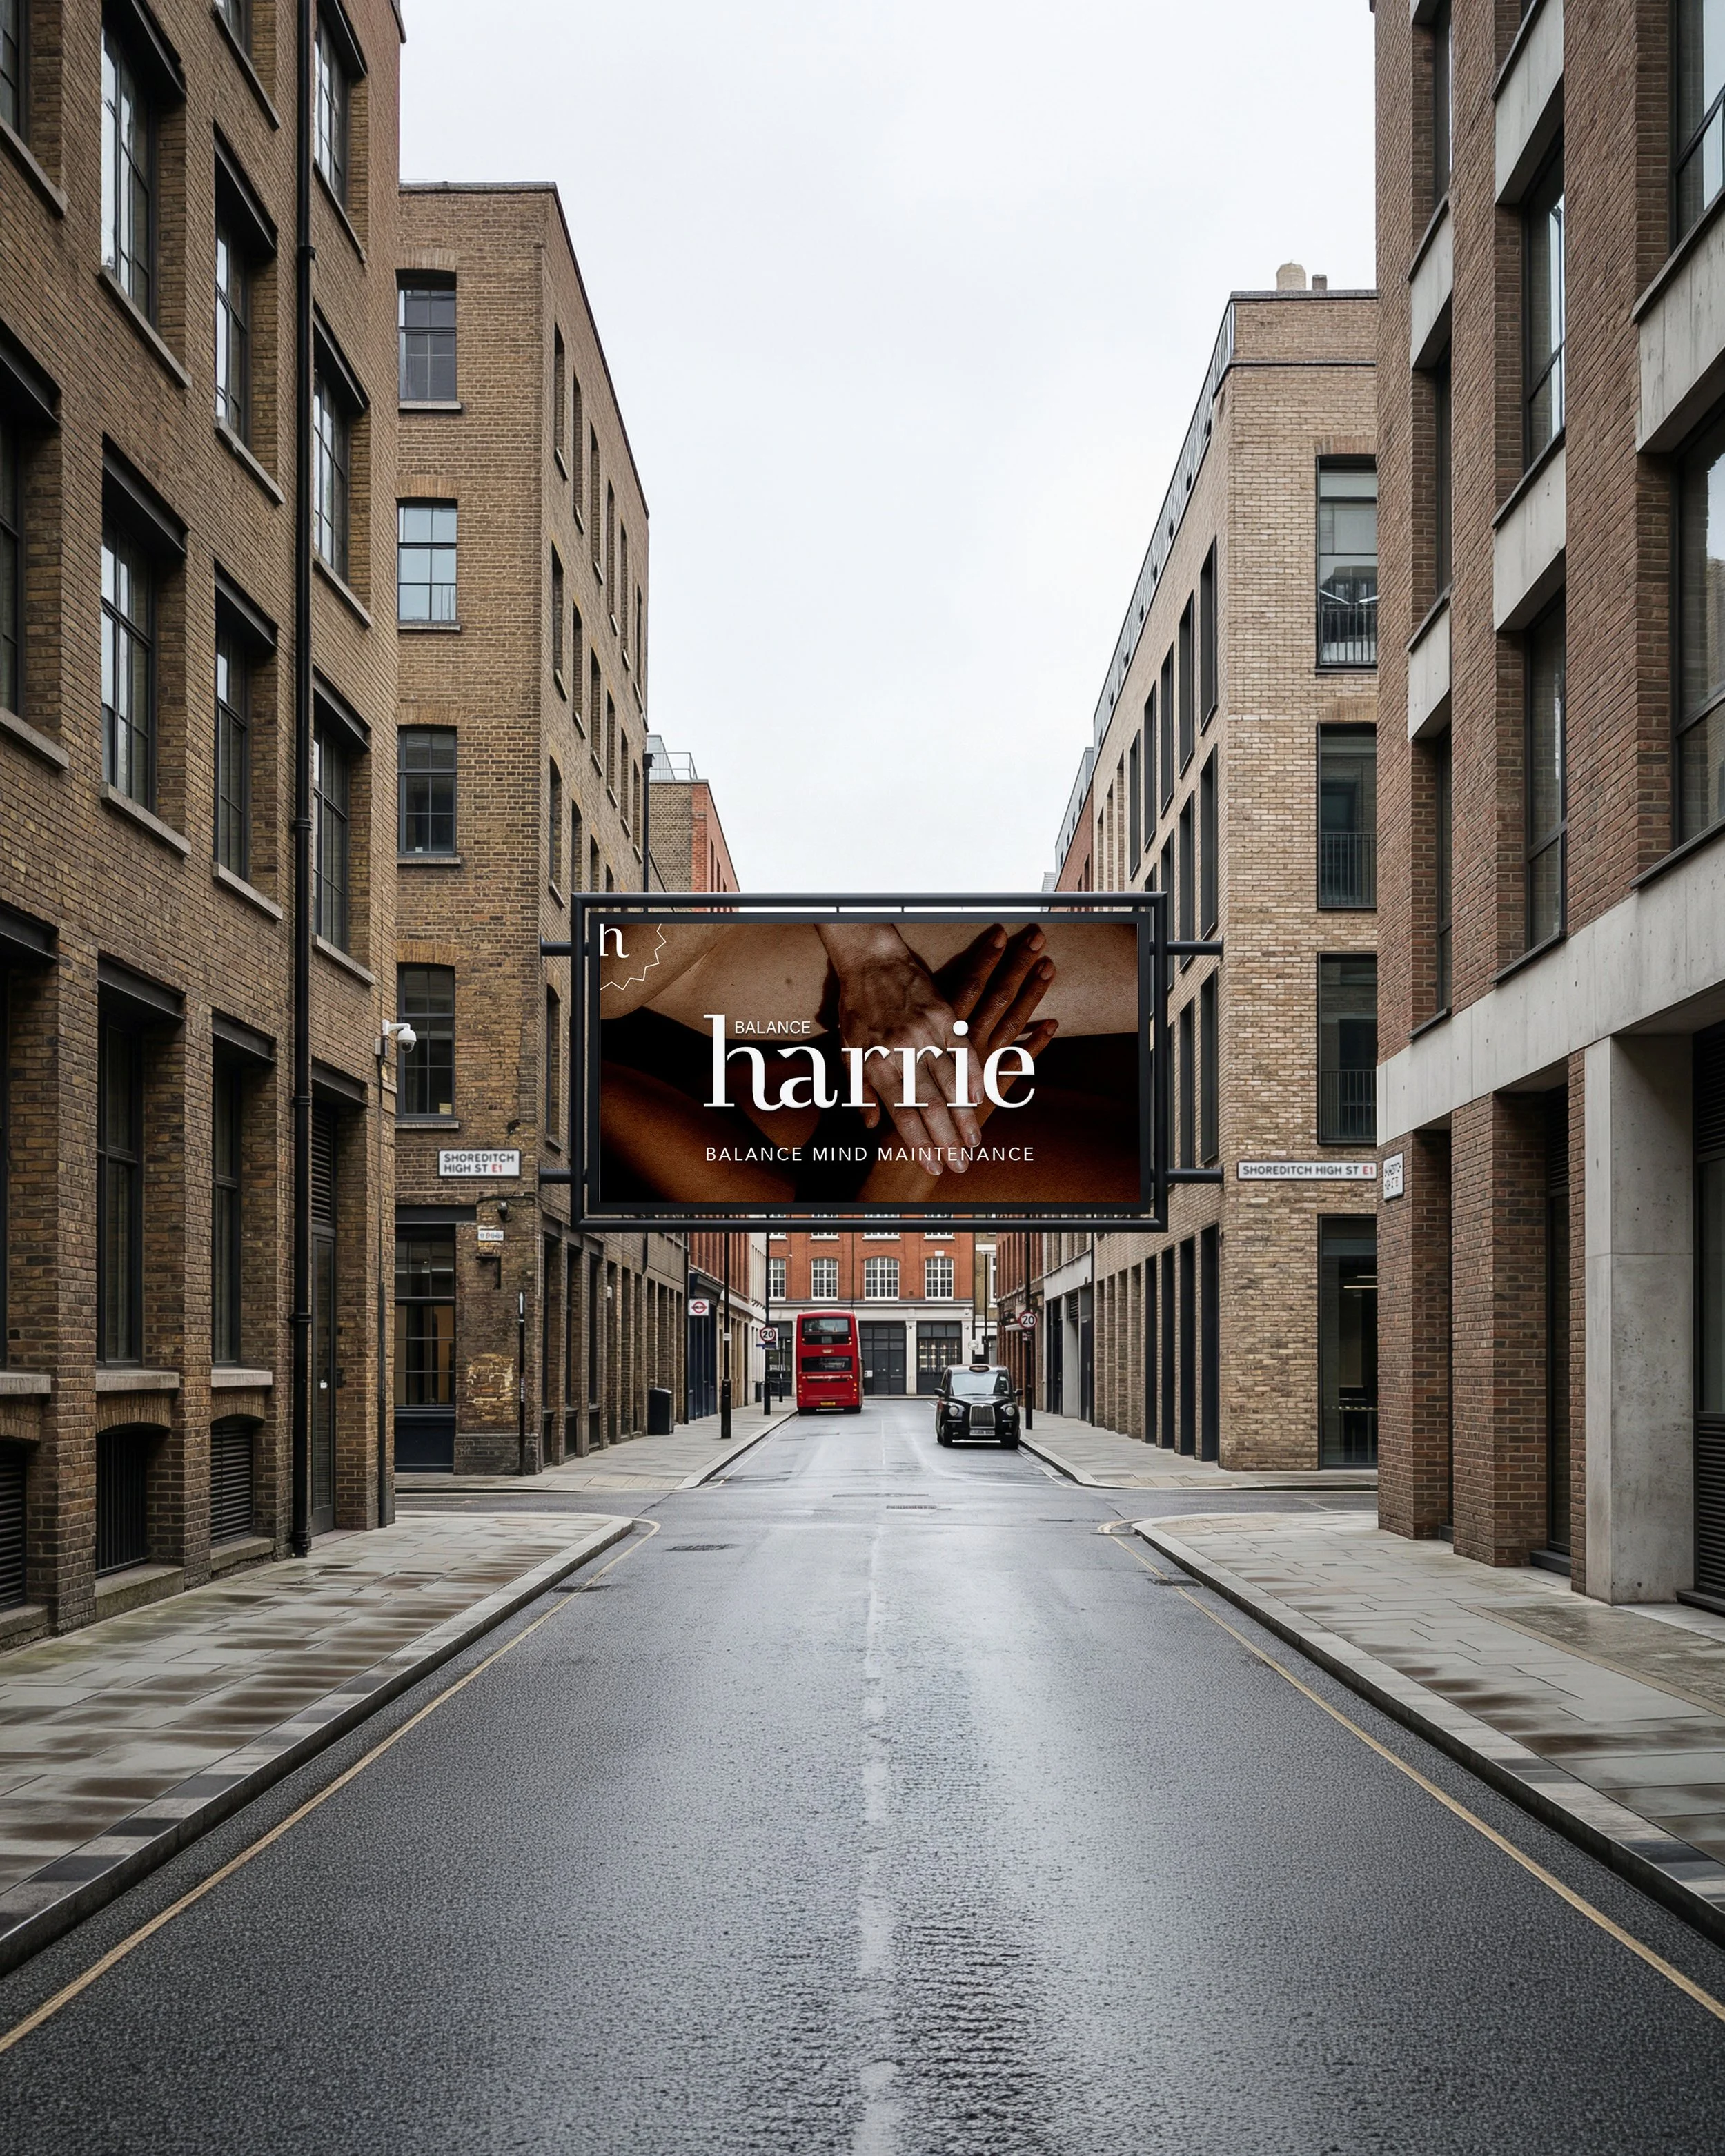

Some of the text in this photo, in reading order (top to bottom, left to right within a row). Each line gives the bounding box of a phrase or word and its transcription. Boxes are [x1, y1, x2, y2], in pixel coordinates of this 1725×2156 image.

[734, 1021, 811, 1035] BALANCE
[703, 1014, 1036, 1112] harrie
[444, 1153, 515, 1163] SHOREDITCH
[706, 1146, 1034, 1162] BALANCE MIND MAINTENANCE
[444, 1164, 503, 1173] HIGH ST E1
[1243, 1165, 1312, 1175] SHOREDITCH
[1315, 1165, 1342, 1175] HIGH
[1346, 1165, 1359, 1175] ST
[1362, 1166, 1374, 1175] E1
[1022, 1315, 1035, 1325] 20
[762, 1330, 773, 1339] 20
